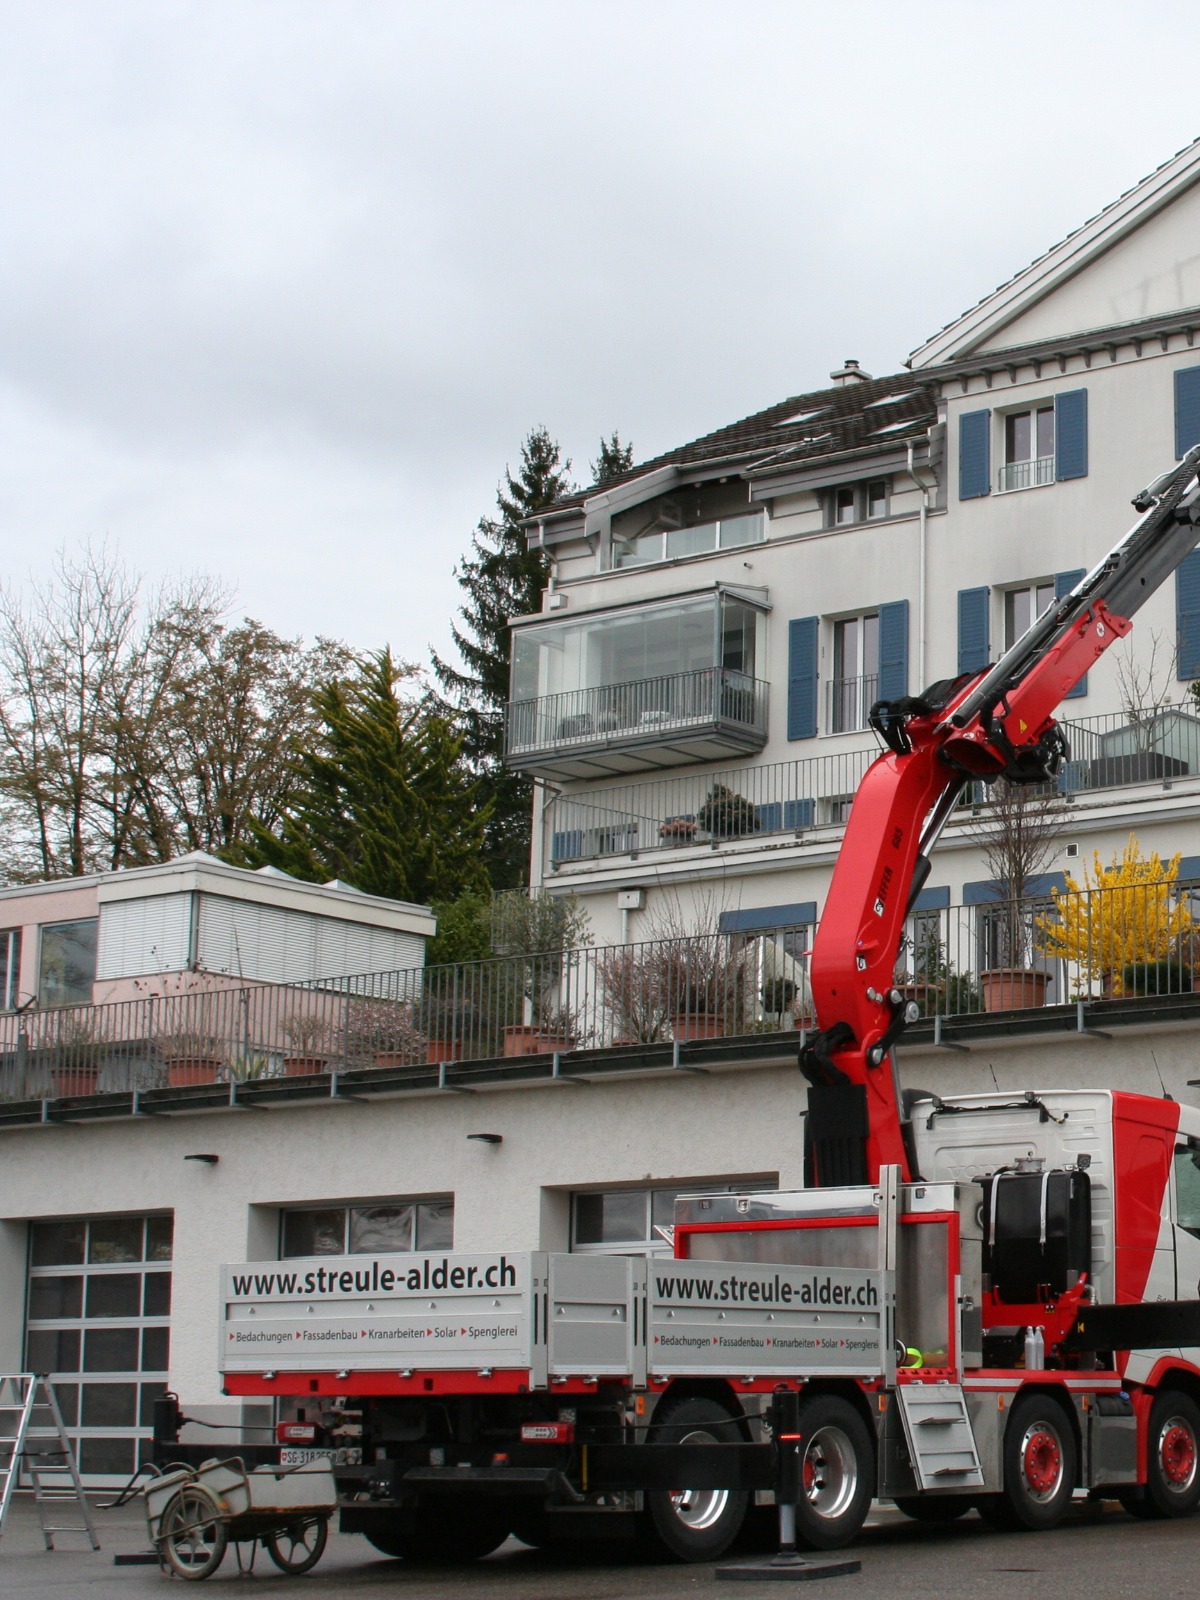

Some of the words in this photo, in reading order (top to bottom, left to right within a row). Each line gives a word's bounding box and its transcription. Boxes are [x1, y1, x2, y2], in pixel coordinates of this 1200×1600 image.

[233, 1256, 517, 1296] www.streule-alder.ch
[656, 1274, 879, 1306] www.streule-alder.ch
[236, 1331, 293, 1344] Bedachungen
[303, 1329, 358, 1341] Fassadenbau
[368, 1328, 425, 1340] Kranarbeiten
[434, 1327, 457, 1338] Solar
[468, 1325, 518, 1339] Spenglerei
[660, 1335, 711, 1348] Bedachungen
[719, 1336, 764, 1347] Fassadenbau
[772, 1337, 815, 1348] Kranarbeiten
[821, 1338, 838, 1348] Solar
[845, 1338, 879, 1351] Spenglerei
